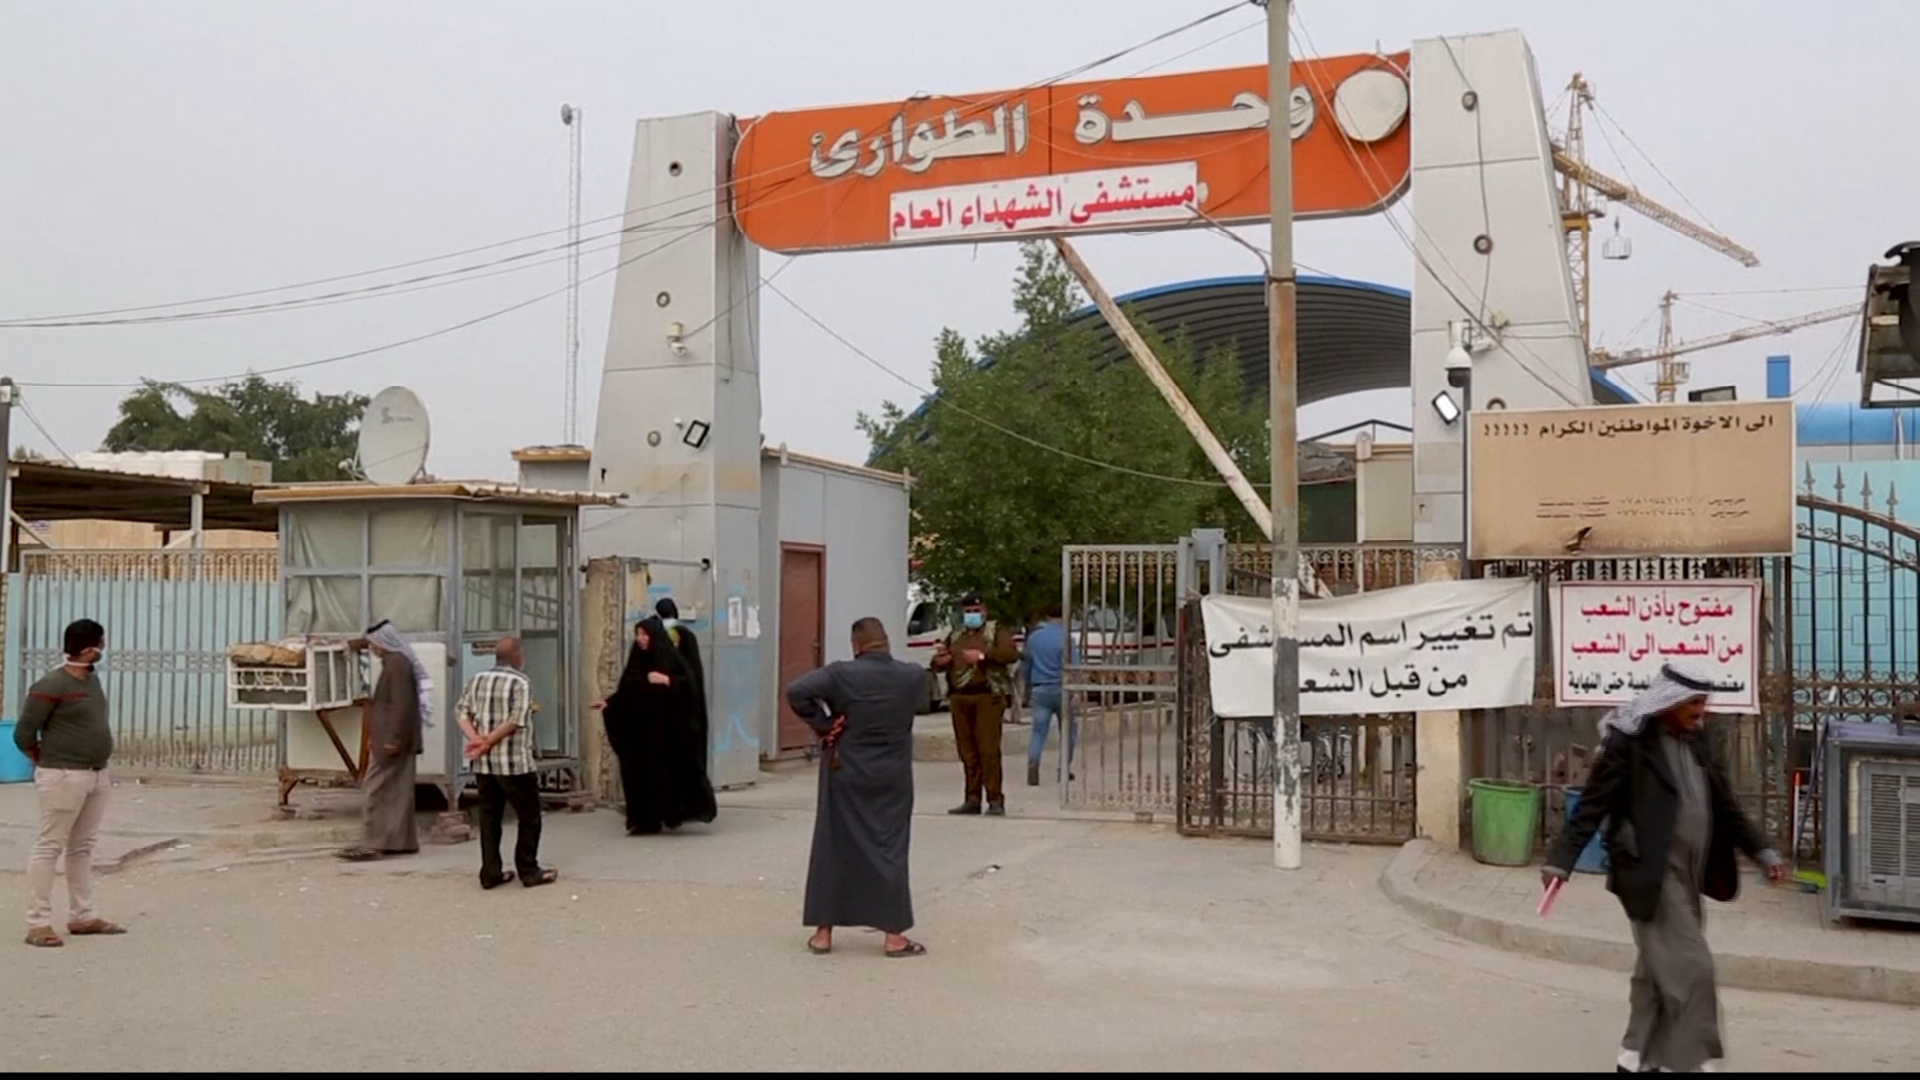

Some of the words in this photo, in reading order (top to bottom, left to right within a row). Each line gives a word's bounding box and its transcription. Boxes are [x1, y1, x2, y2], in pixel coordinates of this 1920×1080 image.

[1074, 84, 1315, 144] وحدة
[809, 100, 1028, 178] الطوارئ
[960, 183, 1062, 229] الشهداء
[1070, 174, 1195, 223] مستشفى
[892, 196, 952, 237] العام
[1539, 421, 1593, 439] الكرام
[1682, 415, 1740, 434] الاخوة
[1745, 415, 1774, 432] الى
[1580, 595, 1636, 623] الشعب
[1678, 597, 1734, 626] مفتوح
[1208, 623, 1354, 658] المسشفى
[1358, 622, 1408, 655] اسم
[1412, 615, 1496, 651] تغيير
[1502, 611, 1534, 650] تم
[1571, 632, 1626, 660] الشعب
[1628, 632, 1655, 661] الى
[1658, 634, 1715, 662] الشعب
[1717, 635, 1744, 663] من
[1300, 668, 1364, 695] الشع
[1369, 664, 1421, 698] قبل
[1426, 667, 1469, 696] من
[1568, 671, 1601, 694] النهاية
[1603, 672, 1624, 694] حتى
